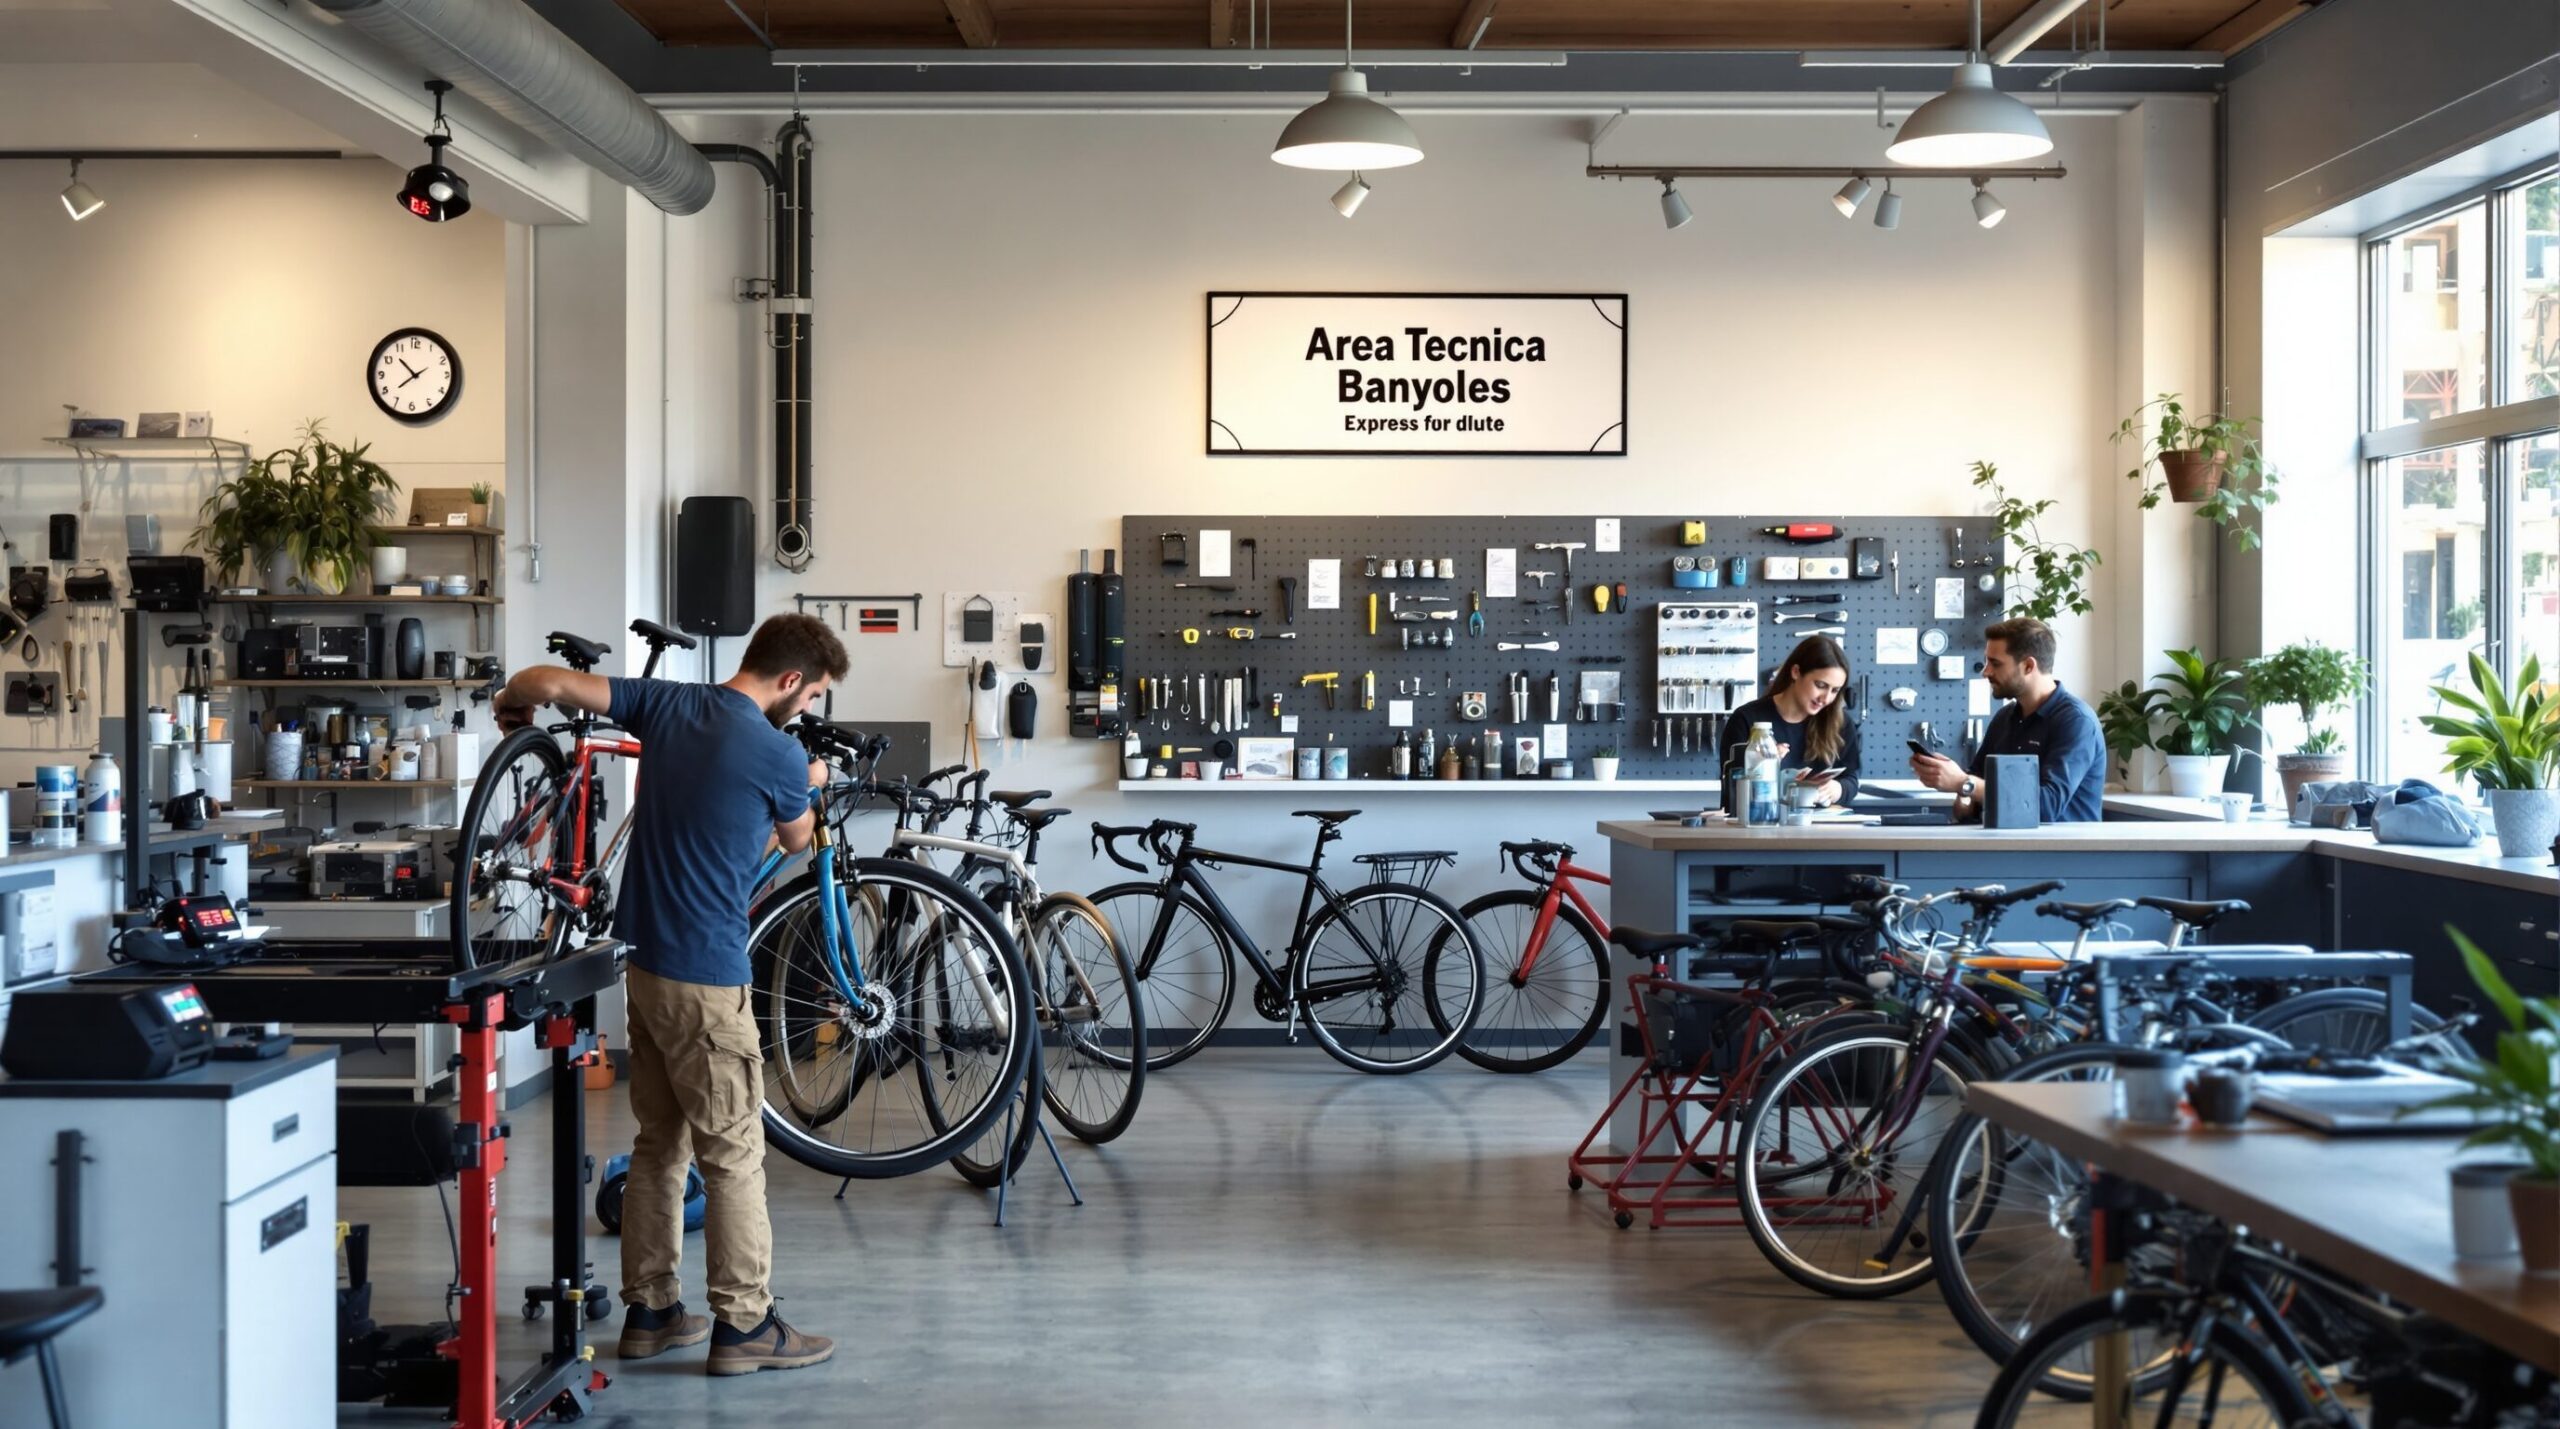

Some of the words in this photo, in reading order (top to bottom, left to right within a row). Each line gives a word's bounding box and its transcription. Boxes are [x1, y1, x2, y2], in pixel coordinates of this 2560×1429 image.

[1305, 327, 1395, 361] Area
[1404, 327, 1546, 362] Tecnica
[1338, 369, 1511, 411] Banyoles
[408, 401, 416, 411] 6
[1344, 415, 1419, 434] Express
